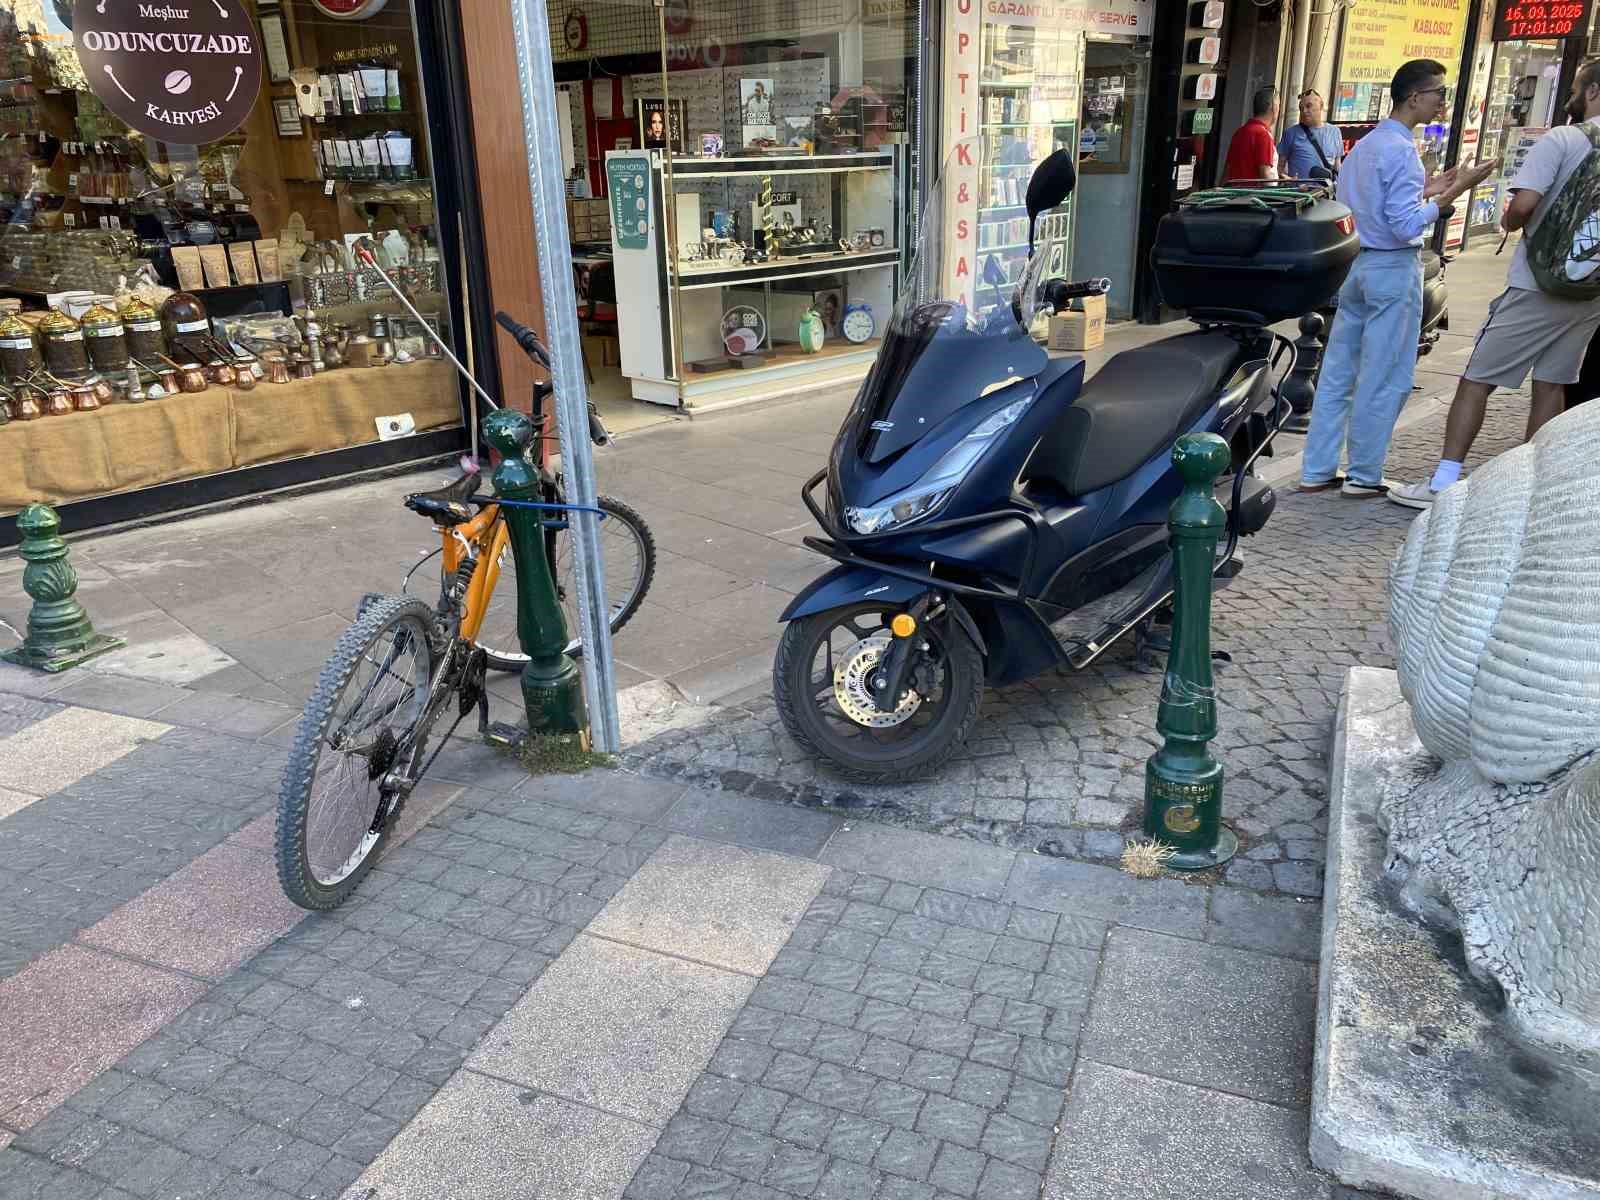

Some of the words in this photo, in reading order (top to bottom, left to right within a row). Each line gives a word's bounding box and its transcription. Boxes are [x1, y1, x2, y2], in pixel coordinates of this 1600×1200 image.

[138, 4, 189, 21] Meşhur
[1412, 18, 1453, 36] KABLOSUZ
[1510, 21, 1571, 37] 17:01:00
[82, 31, 251, 54] ODUNCUZADE
[145, 101, 222, 126] KAHVESİ
